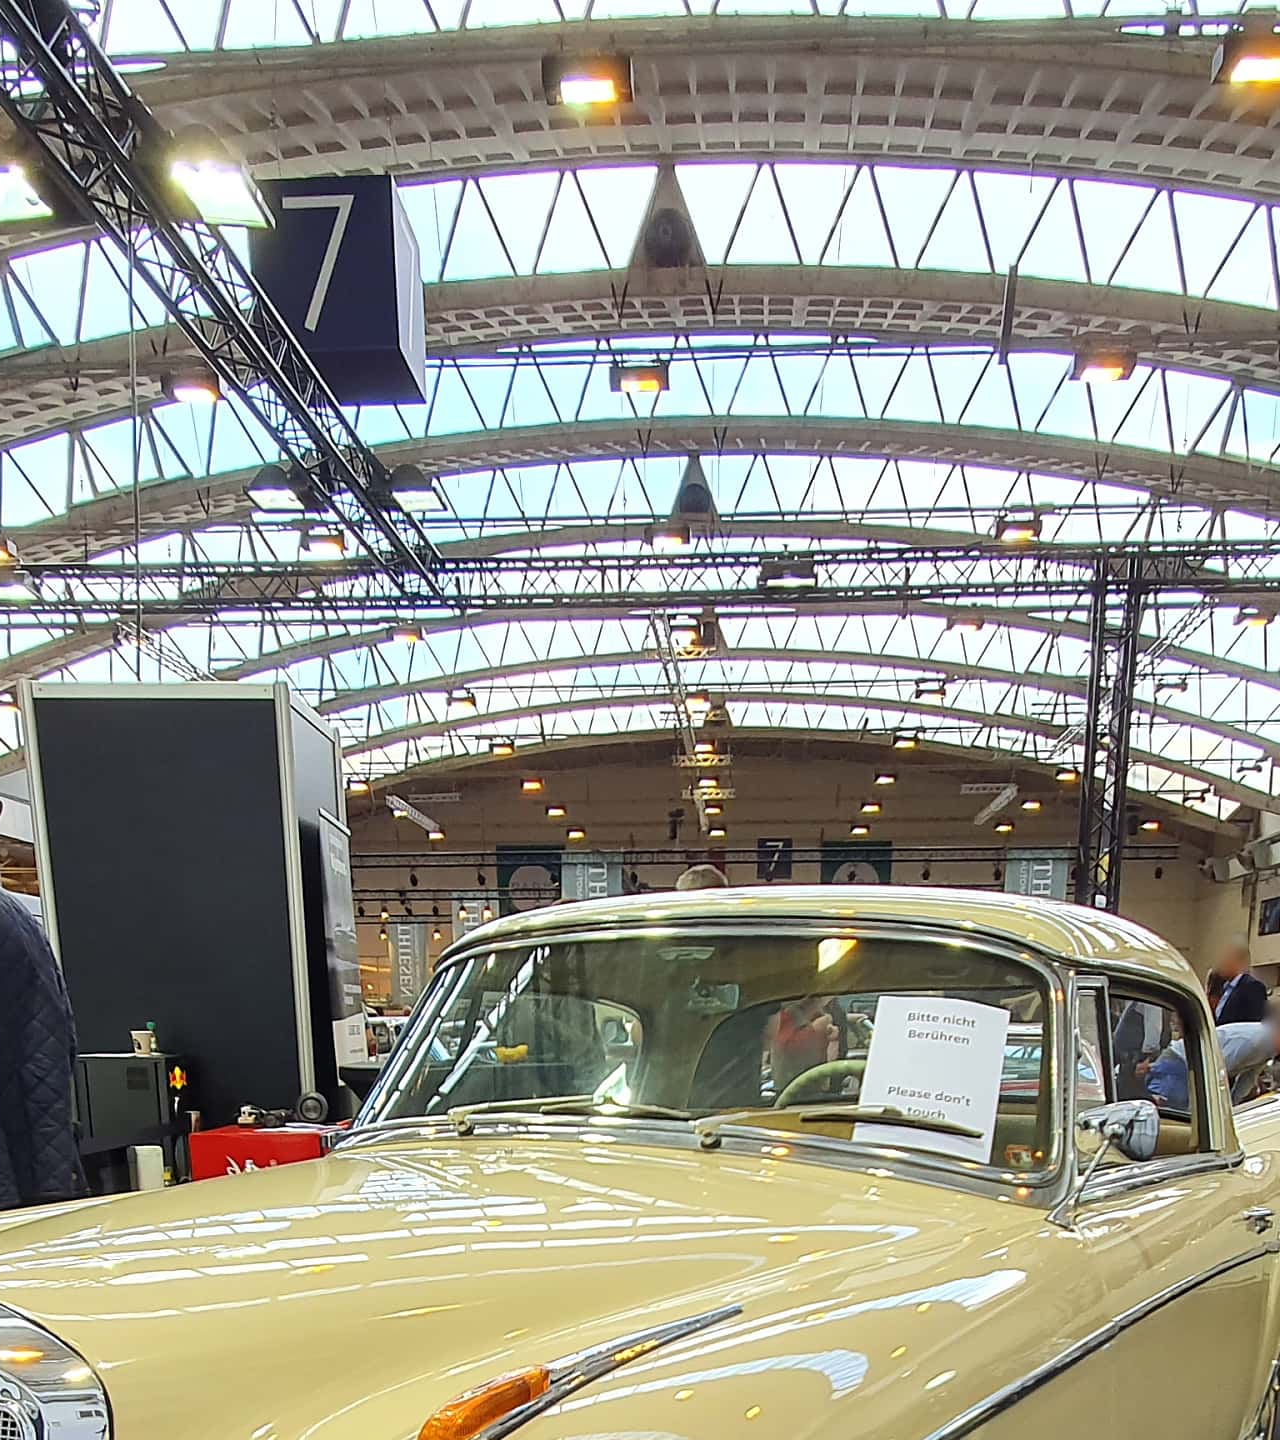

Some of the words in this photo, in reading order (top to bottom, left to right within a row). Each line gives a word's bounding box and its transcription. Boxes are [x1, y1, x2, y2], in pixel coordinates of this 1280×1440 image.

[281, 194, 355, 333] 7
[765, 841, 784, 872] 7
[907, 1012, 940, 1023] Bitte
[943, 1015, 976, 1028] nicht
[907, 1029, 970, 1045] Berühren
[887, 1086, 932, 1099] Please
[934, 1091, 971, 1107] don't
[906, 1106, 947, 1120] touch
